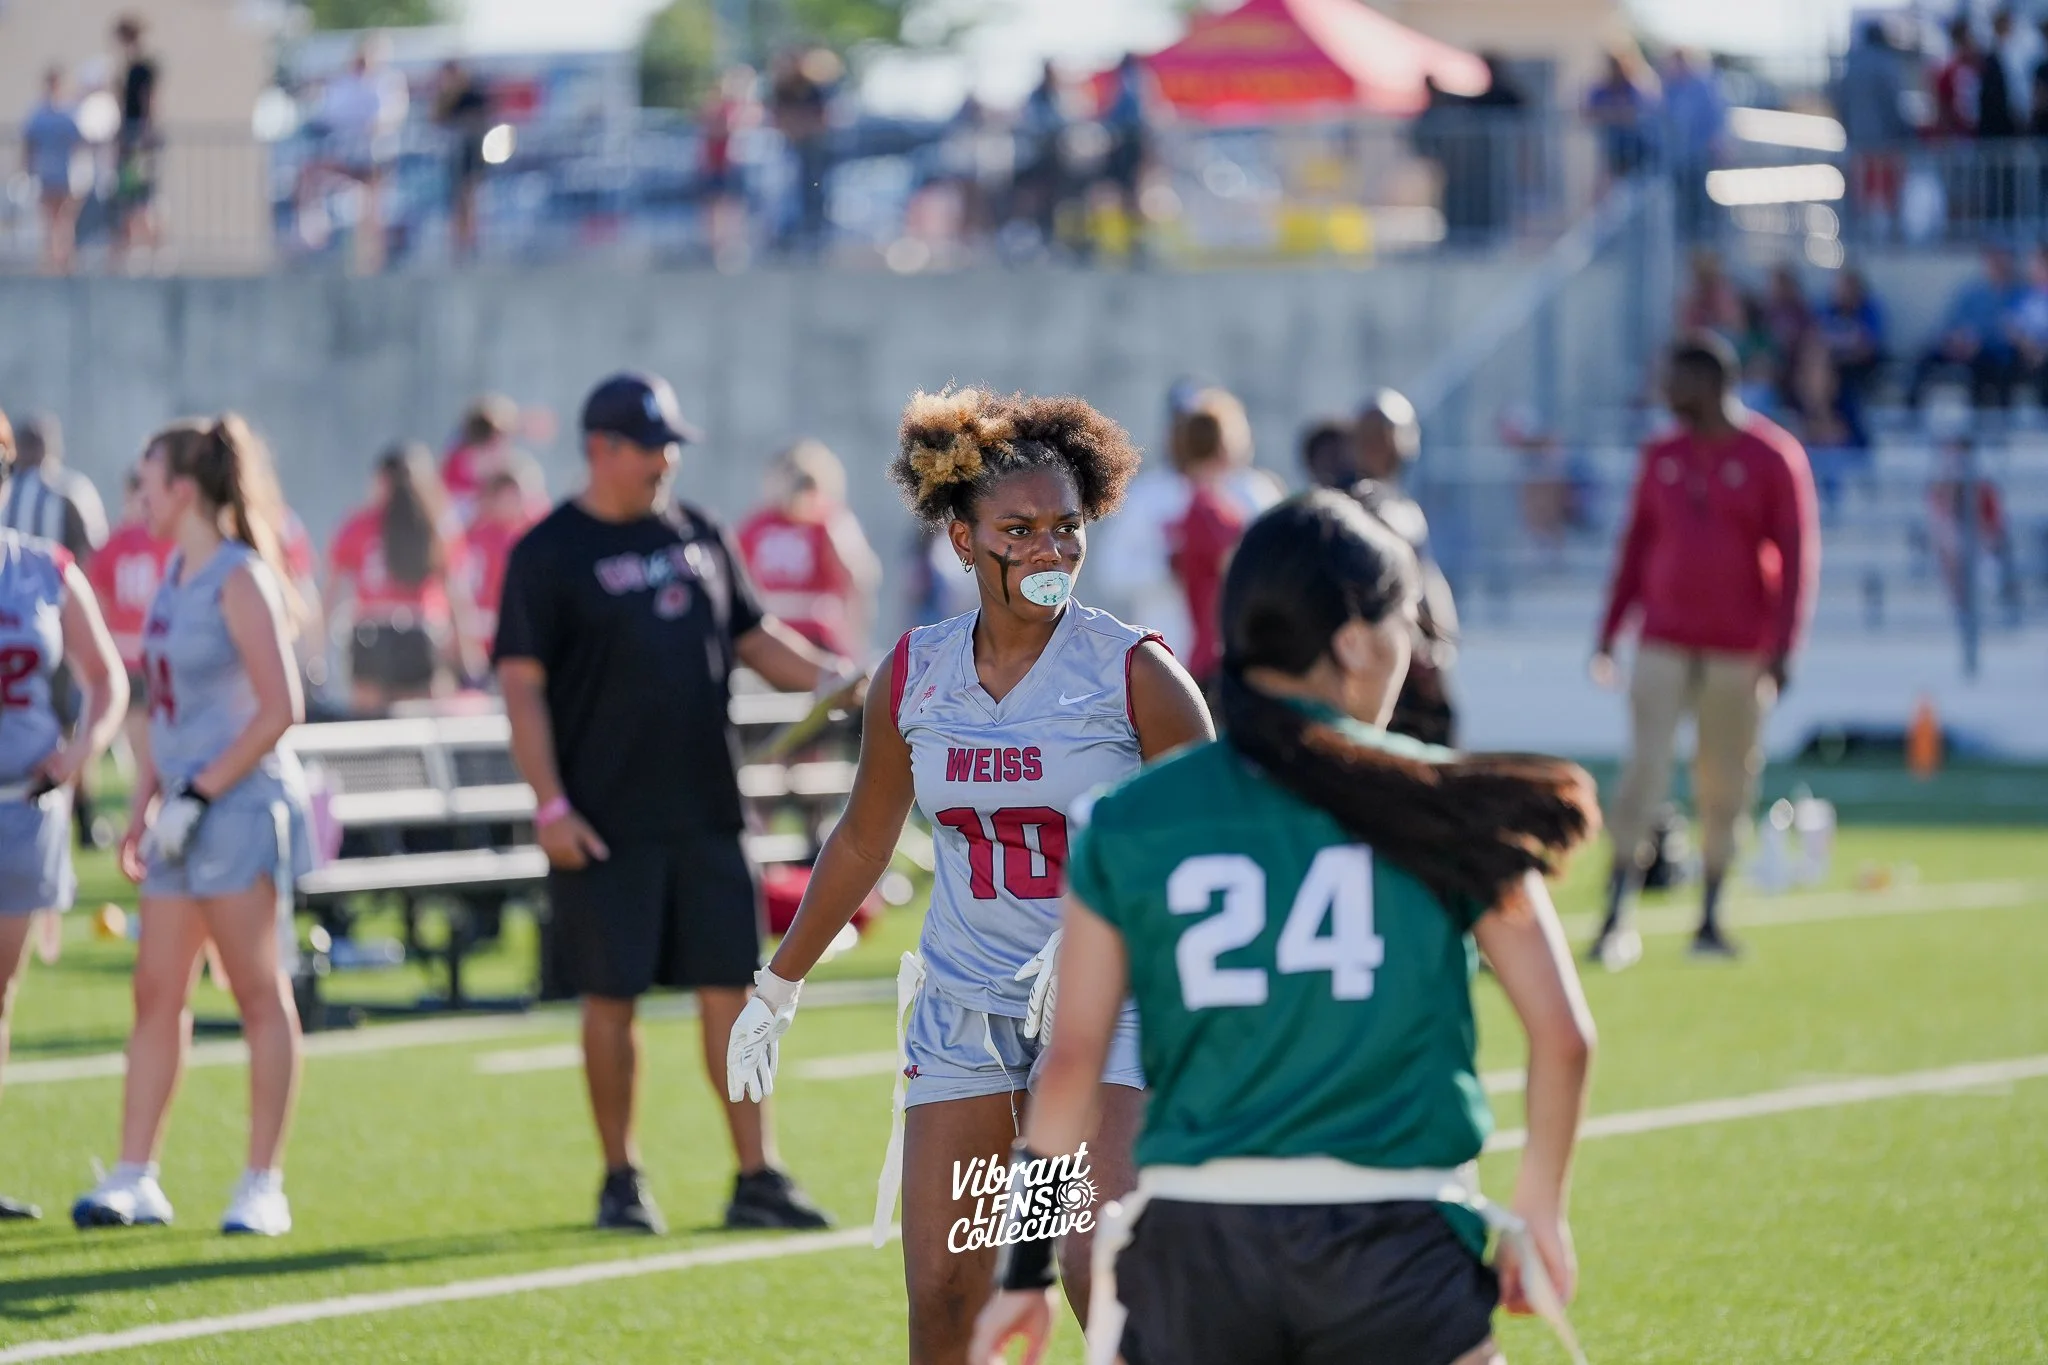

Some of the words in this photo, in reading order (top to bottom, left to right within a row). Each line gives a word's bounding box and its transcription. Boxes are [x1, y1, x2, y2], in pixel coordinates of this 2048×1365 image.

[946, 746, 1043, 782] WEISS
[935, 806, 1071, 900] 10
[1166, 843, 1385, 1011] 24
